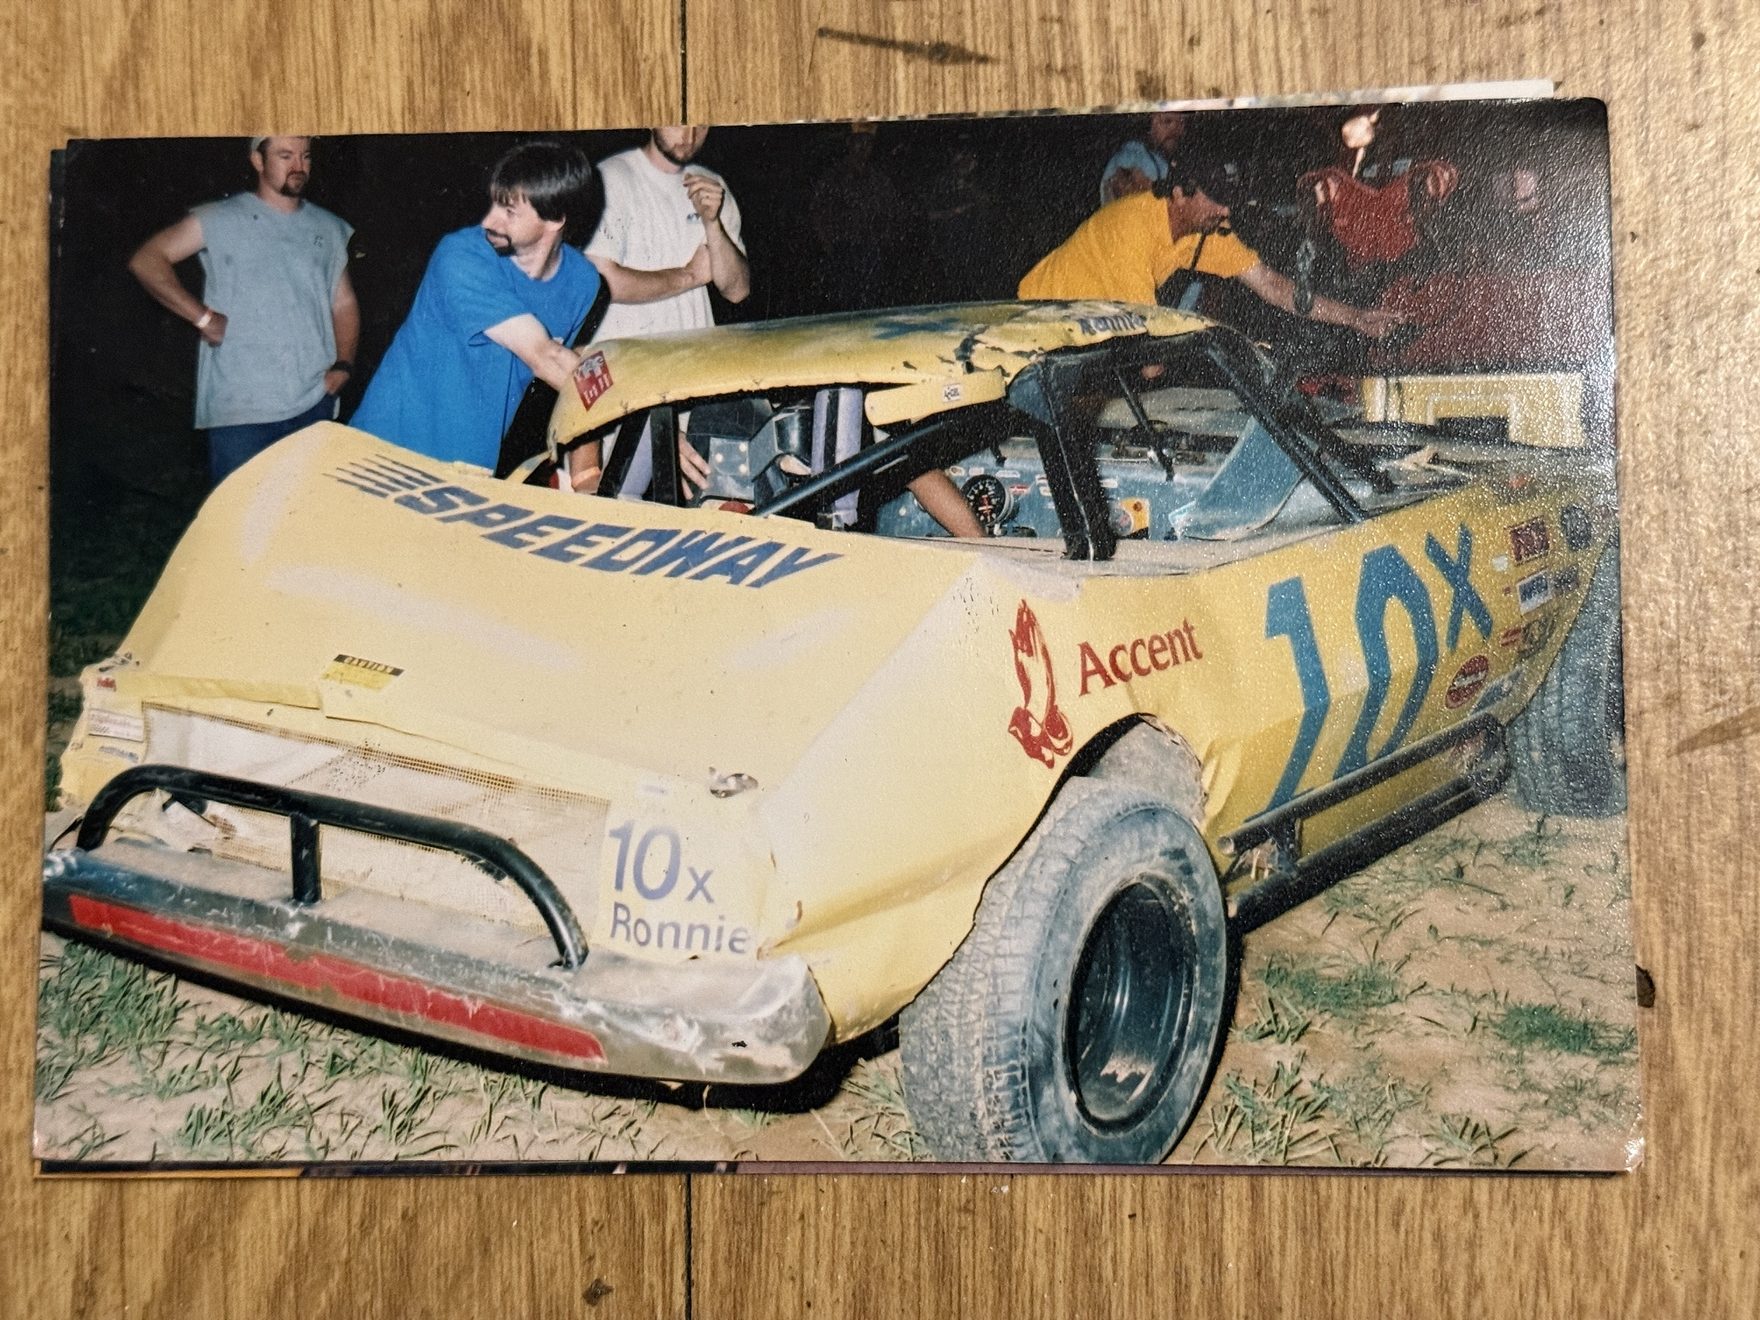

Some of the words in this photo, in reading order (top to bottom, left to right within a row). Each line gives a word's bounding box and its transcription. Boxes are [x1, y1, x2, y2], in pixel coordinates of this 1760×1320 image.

[393, 484, 845, 588] SPEEDWAY
[1078, 616, 1203, 697] Accent
[610, 900, 749, 954] Ronnie
